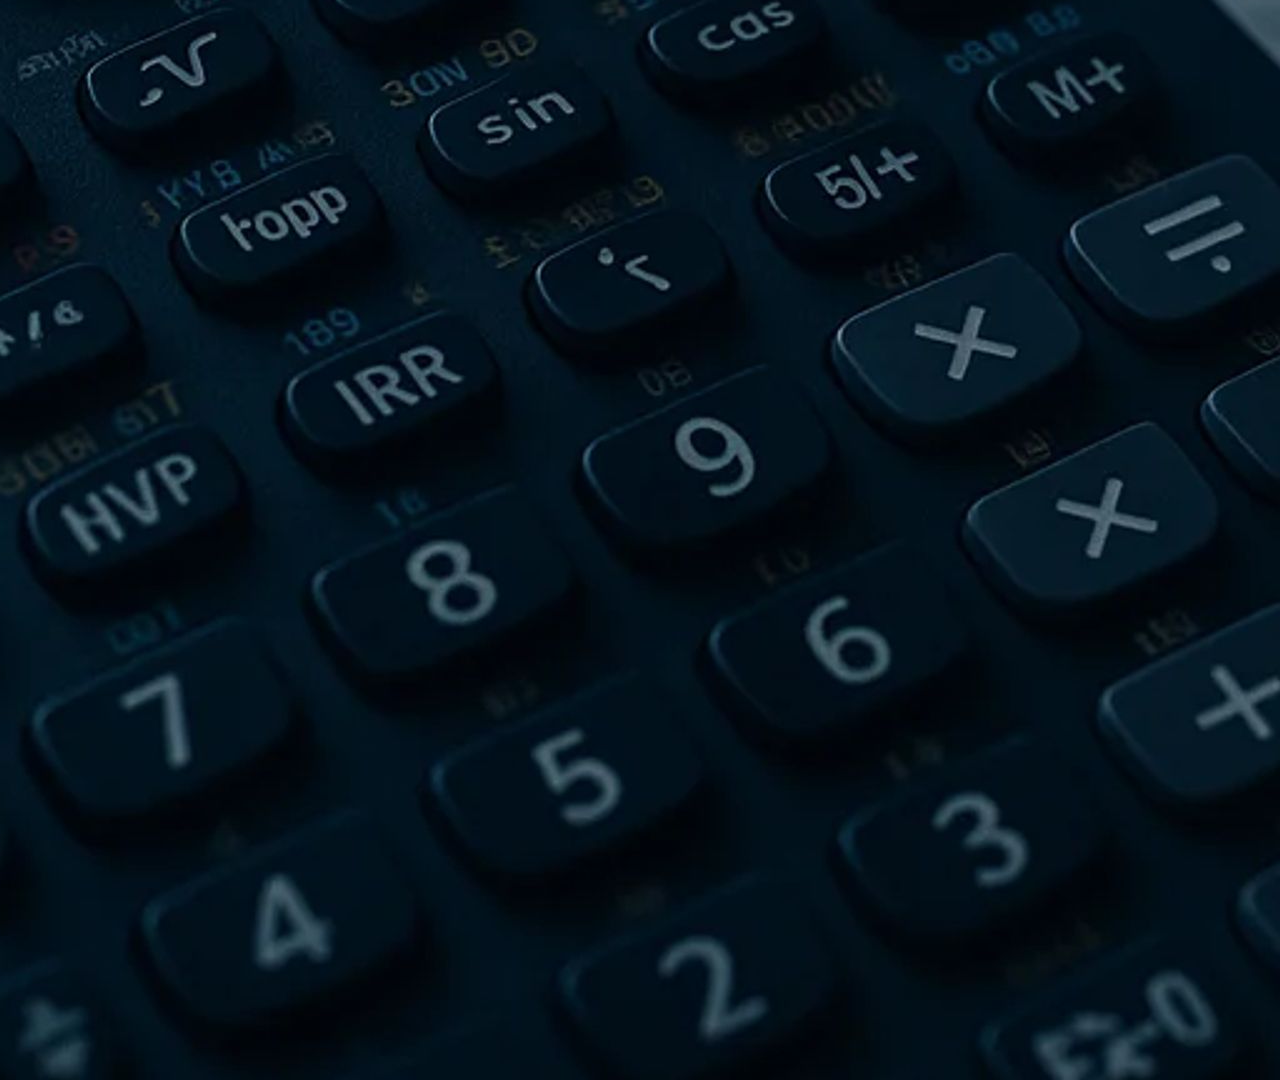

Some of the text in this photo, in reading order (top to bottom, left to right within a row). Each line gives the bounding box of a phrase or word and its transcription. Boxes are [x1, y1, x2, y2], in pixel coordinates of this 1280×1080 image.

[696, 0, 797, 52] cas
[476, 88, 577, 147] sin
[1026, 55, 1125, 120] M+
[331, 343, 465, 428] IRR
[673, 415, 757, 499] 9
[60, 453, 199, 557] HVP
[404, 538, 499, 628] 8
[802, 593, 892, 686] 6
[119, 670, 193, 770] 7
[529, 724, 624, 829] 5
[930, 788, 1031, 892] 3
[250, 870, 336, 973] 4
[654, 932, 772, 1046] 2
